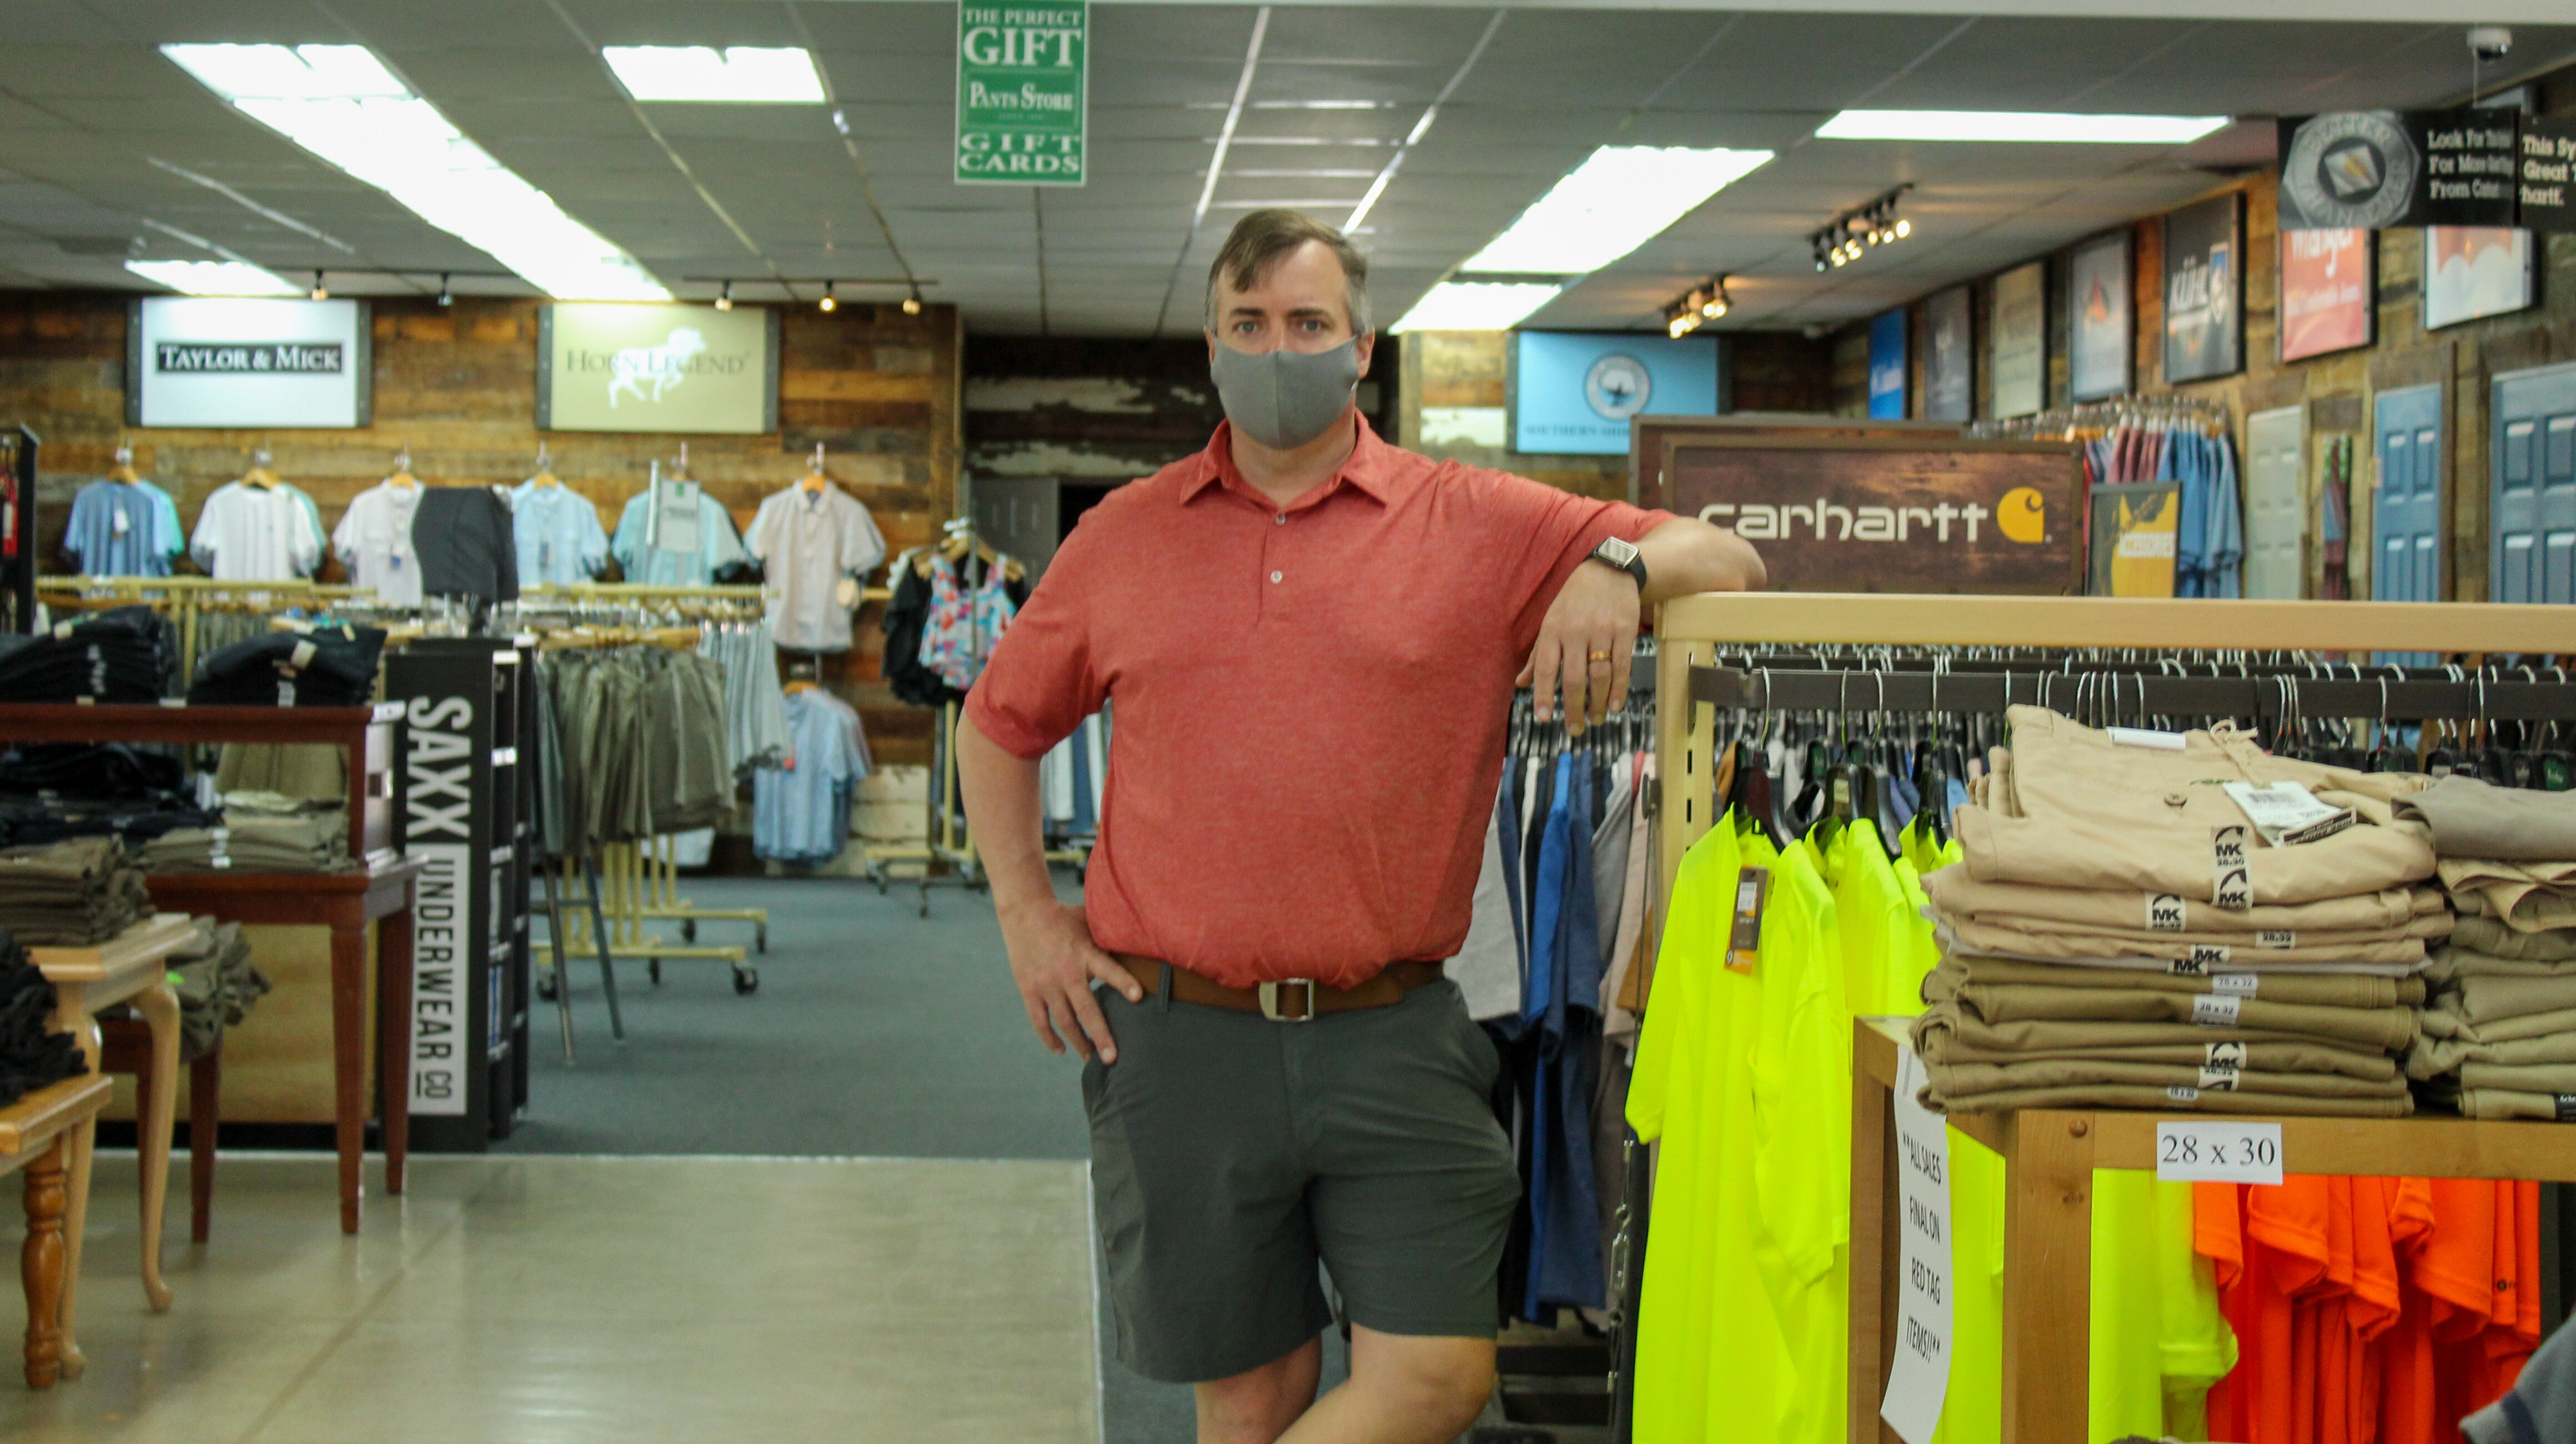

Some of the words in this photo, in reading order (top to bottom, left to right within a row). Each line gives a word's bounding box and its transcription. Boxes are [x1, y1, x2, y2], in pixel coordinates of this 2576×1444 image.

[965, 8, 1000, 24] THE
[1004, 9, 1081, 26] PERFECT
[963, 27, 1083, 66] GIFT
[960, 133, 1081, 153] GIFT
[2522, 133, 2554, 156] This
[958, 153, 1080, 173] CARDS
[2523, 159, 2568, 182] Great
[159, 344, 250, 370] TAYLOR
[253, 349, 271, 370] &
[275, 345, 340, 370] MICK
[1698, 499, 1989, 543] carhartt
[406, 696, 473, 838] SAXX
[2216, 844, 2242, 856] MK
[2218, 891, 2246, 902] MK
[2152, 907, 2181, 920] MK
[416, 859, 454, 1060] UNDERWEAR
[2174, 959, 2203, 971] MK
[2195, 949, 2223, 961] MK
[424, 1069, 453, 1100] CO
[2162, 1134, 2198, 1164] 28
[2211, 1144, 2227, 1165] x
[2239, 1136, 2276, 1166] 30
[1921, 1144, 1942, 1186] SALES
[1909, 1194, 1929, 1236] FINAL
[1929, 1209, 1941, 1245] ON
[1911, 1256, 1925, 1293] RED
[1926, 1266, 1941, 1306] TAG
